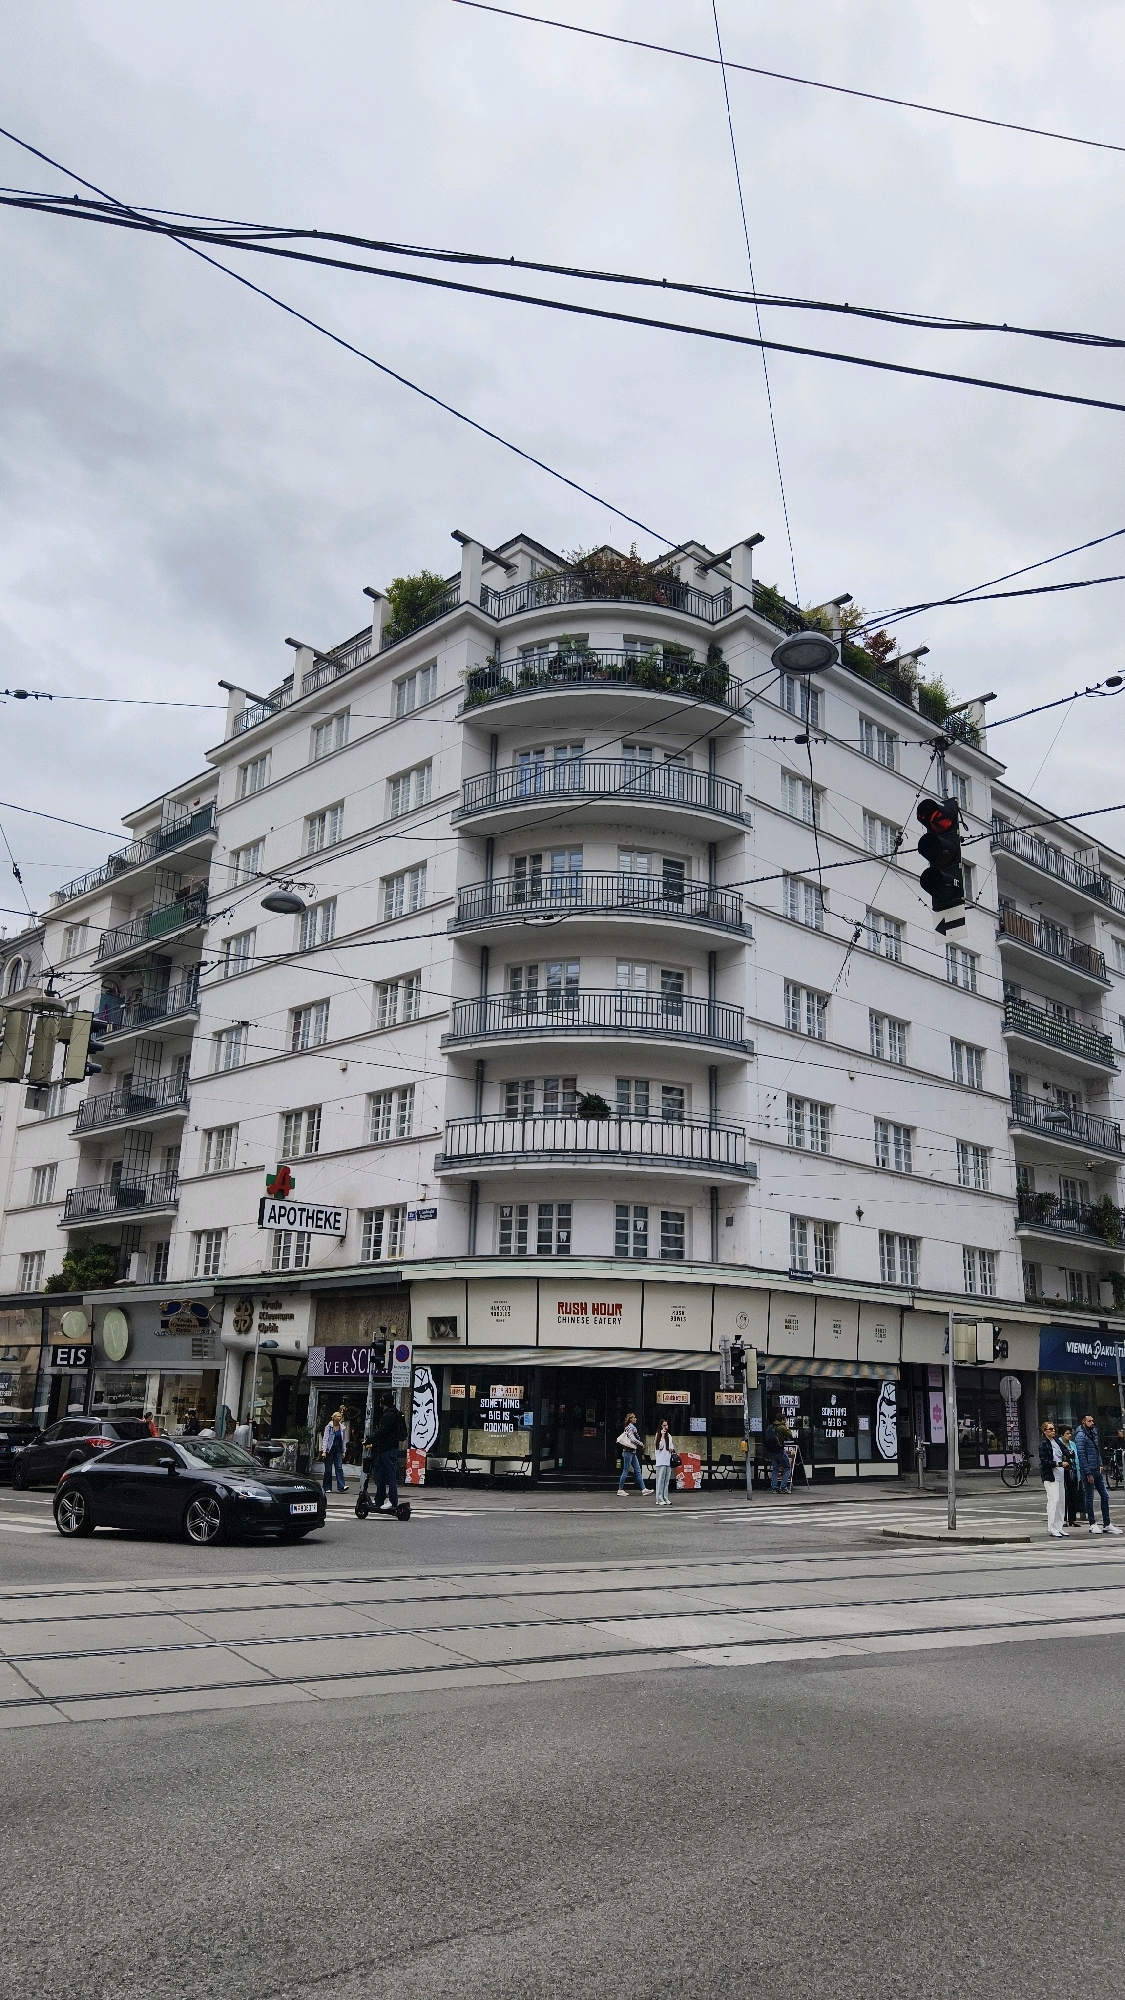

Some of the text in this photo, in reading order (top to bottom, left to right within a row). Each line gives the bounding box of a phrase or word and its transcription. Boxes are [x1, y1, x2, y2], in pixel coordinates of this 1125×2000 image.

[268, 1205, 342, 1230] APOTHEKE
[557, 1301, 623, 1317] RUSH HOUR
[557, 1316, 622, 1325] CHINESE EATERY
[1065, 1341, 1093, 1355] VIENNA
[56, 1348, 87, 1365] EIS
[480, 1399, 520, 1408] SOMETHING
[488, 1410, 510, 1421] BIG IS
[821, 1407, 847, 1417] SOMETHING
[484, 1423, 513, 1432] COOKING
[827, 1418, 836, 1427] BIG
[825, 1429, 845, 1438] COOKING
